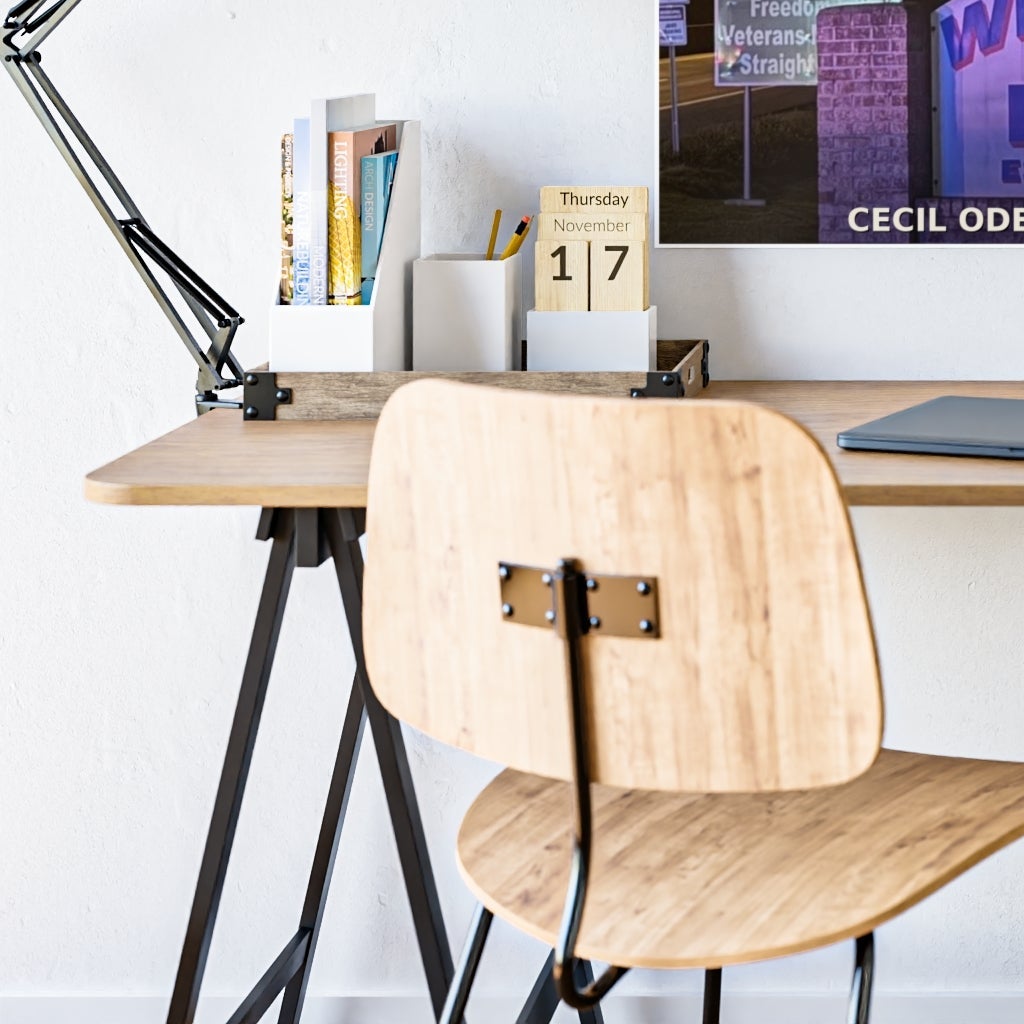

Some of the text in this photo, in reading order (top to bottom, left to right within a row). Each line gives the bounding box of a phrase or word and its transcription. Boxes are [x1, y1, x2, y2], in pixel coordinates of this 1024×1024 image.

[721, 25, 806, 46] Veterans
[334, 141, 347, 219] LIGHTING
[364, 161, 374, 231] ARCH DESIGN
[560, 191, 629, 209] Thursday
[554, 218, 631, 233] November
[847, 206, 947, 233] CECIL
